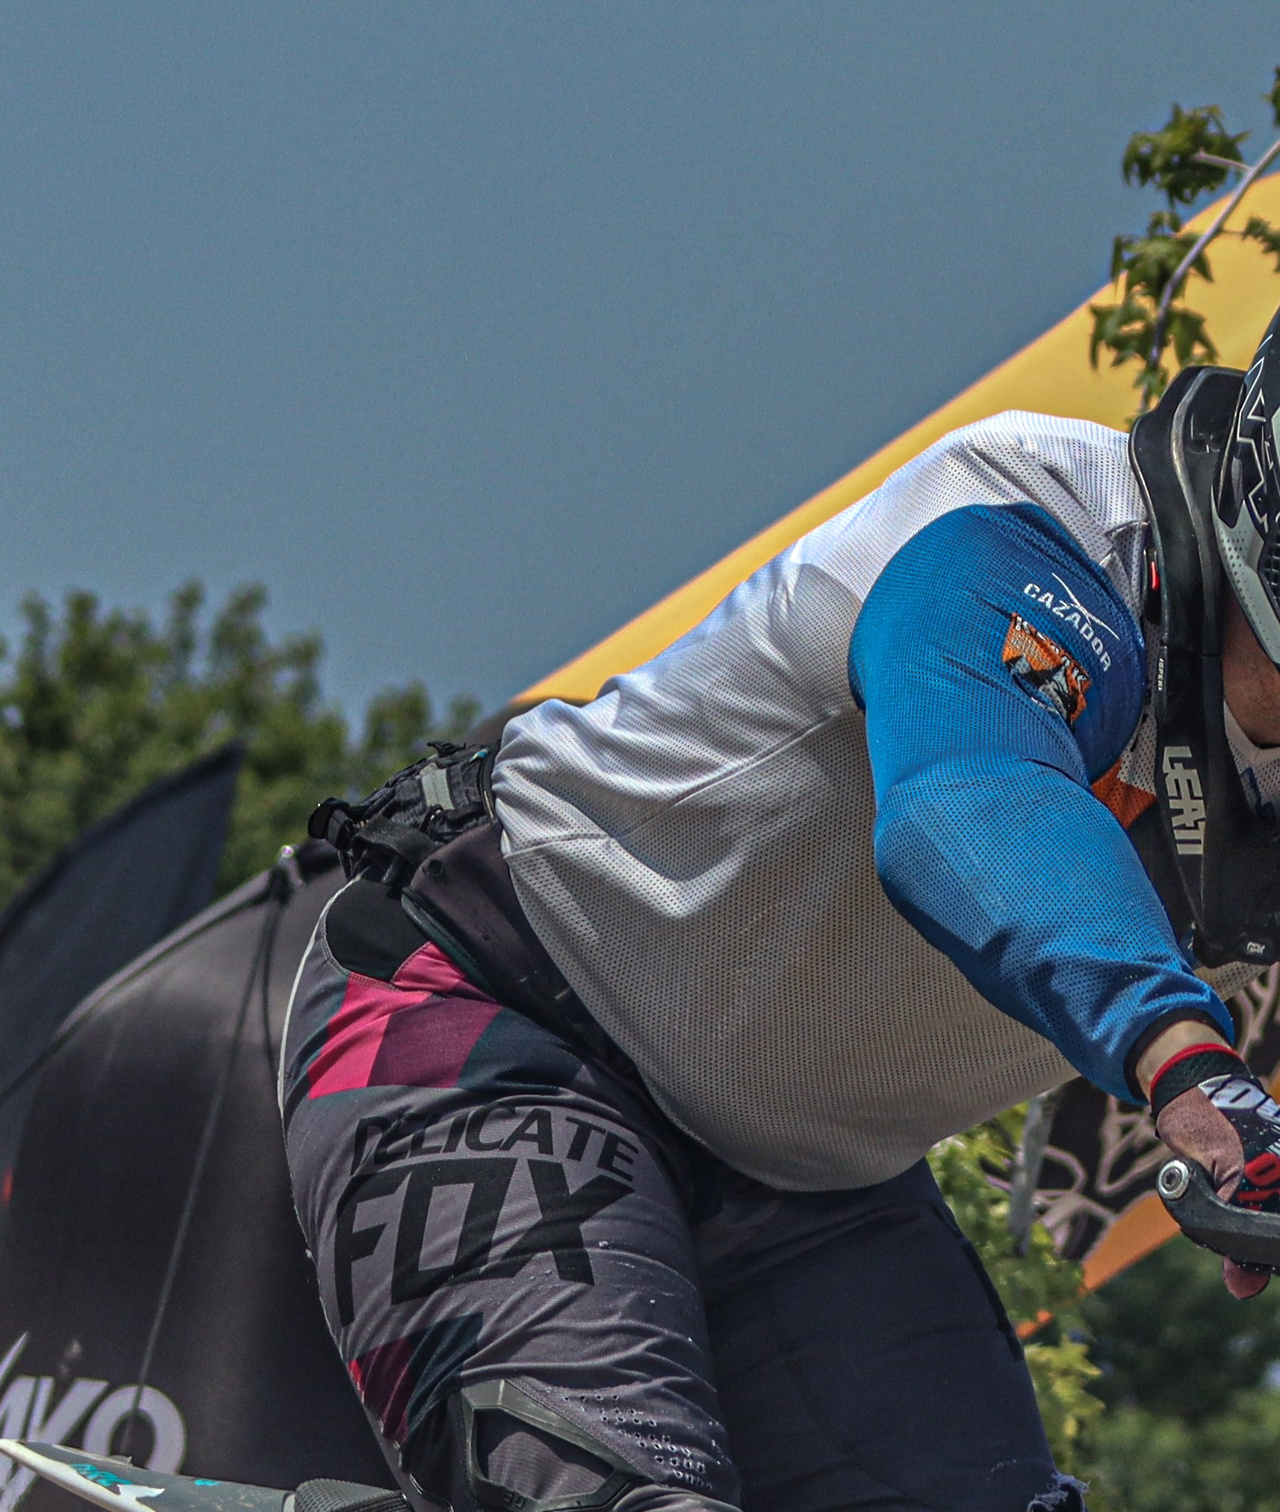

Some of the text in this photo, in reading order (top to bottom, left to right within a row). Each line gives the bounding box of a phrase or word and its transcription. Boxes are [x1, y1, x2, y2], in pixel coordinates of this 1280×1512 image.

[1023, 583, 1113, 673] CAZADOR
[350, 1105, 639, 1184] DELICATE
[333, 1156, 634, 1327] FOX
